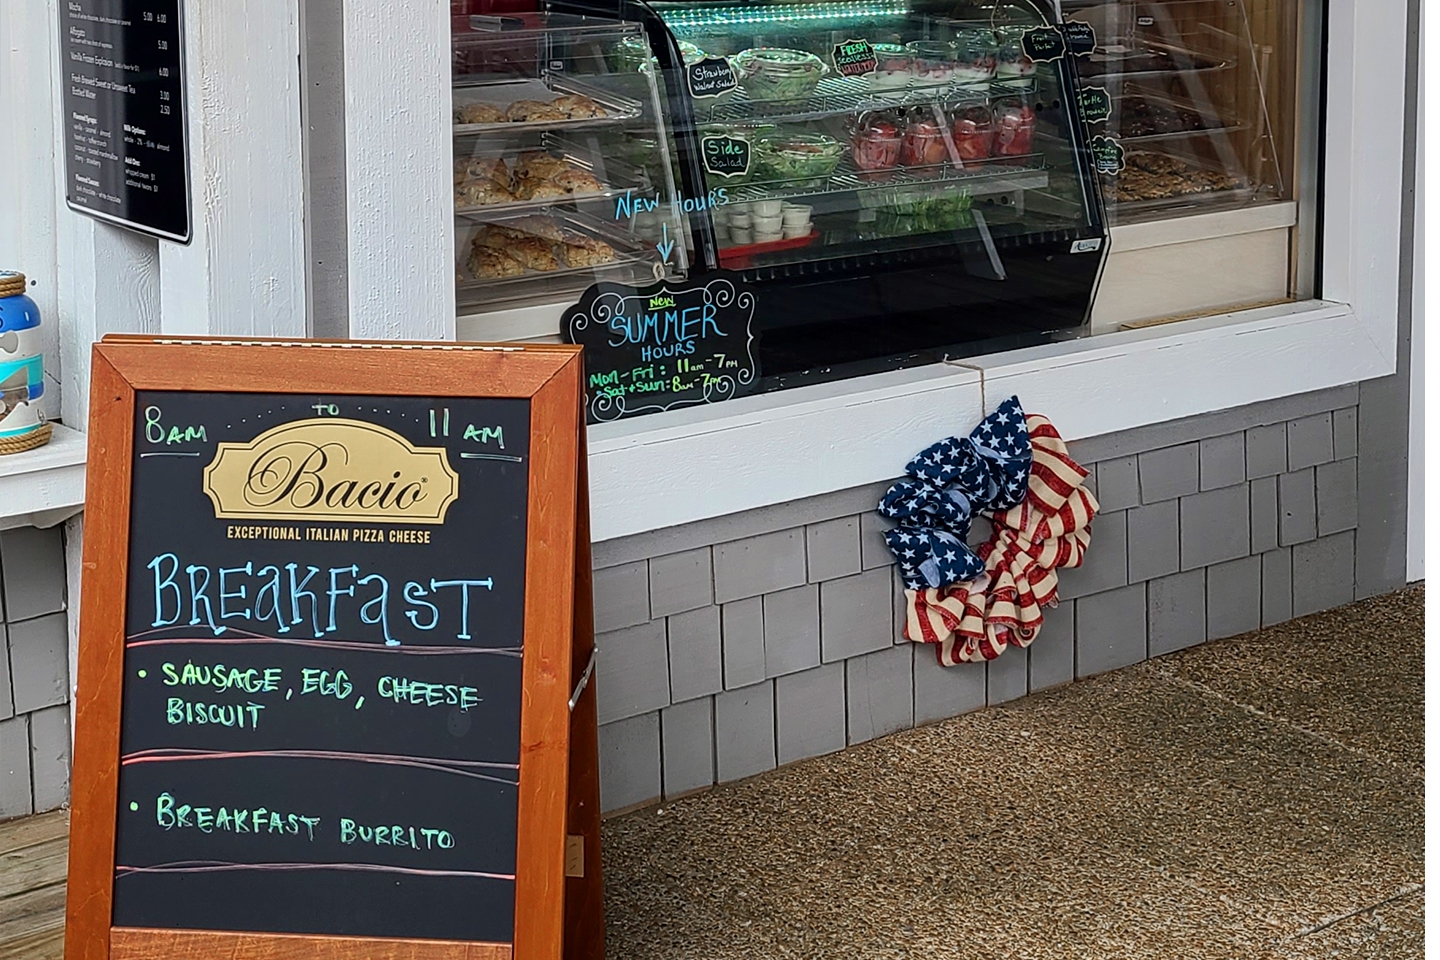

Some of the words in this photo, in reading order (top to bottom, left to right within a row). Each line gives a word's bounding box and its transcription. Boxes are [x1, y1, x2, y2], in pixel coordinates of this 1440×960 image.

[707, 139, 744, 155] Side
[710, 156, 746, 168] Salad
[615, 190, 660, 221] NEW
[671, 187, 730, 216] HOURS
[608, 303, 729, 347] SUMMER
[641, 340, 696, 362] HOURS
[463, 424, 506, 450] AM
[243, 440, 428, 510] Bacio
[226, 525, 302, 541] EXCEPTIONAL
[305, 527, 349, 542] ITALIAN
[353, 528, 385, 543] PIZZA
[389, 529, 431, 545] CHEESE
[377, 675, 484, 713] CHEESE
[166, 697, 266, 731] BISCUIT
[156, 792, 321, 841] BREAKFAST
[340, 817, 456, 851] BURRITO
